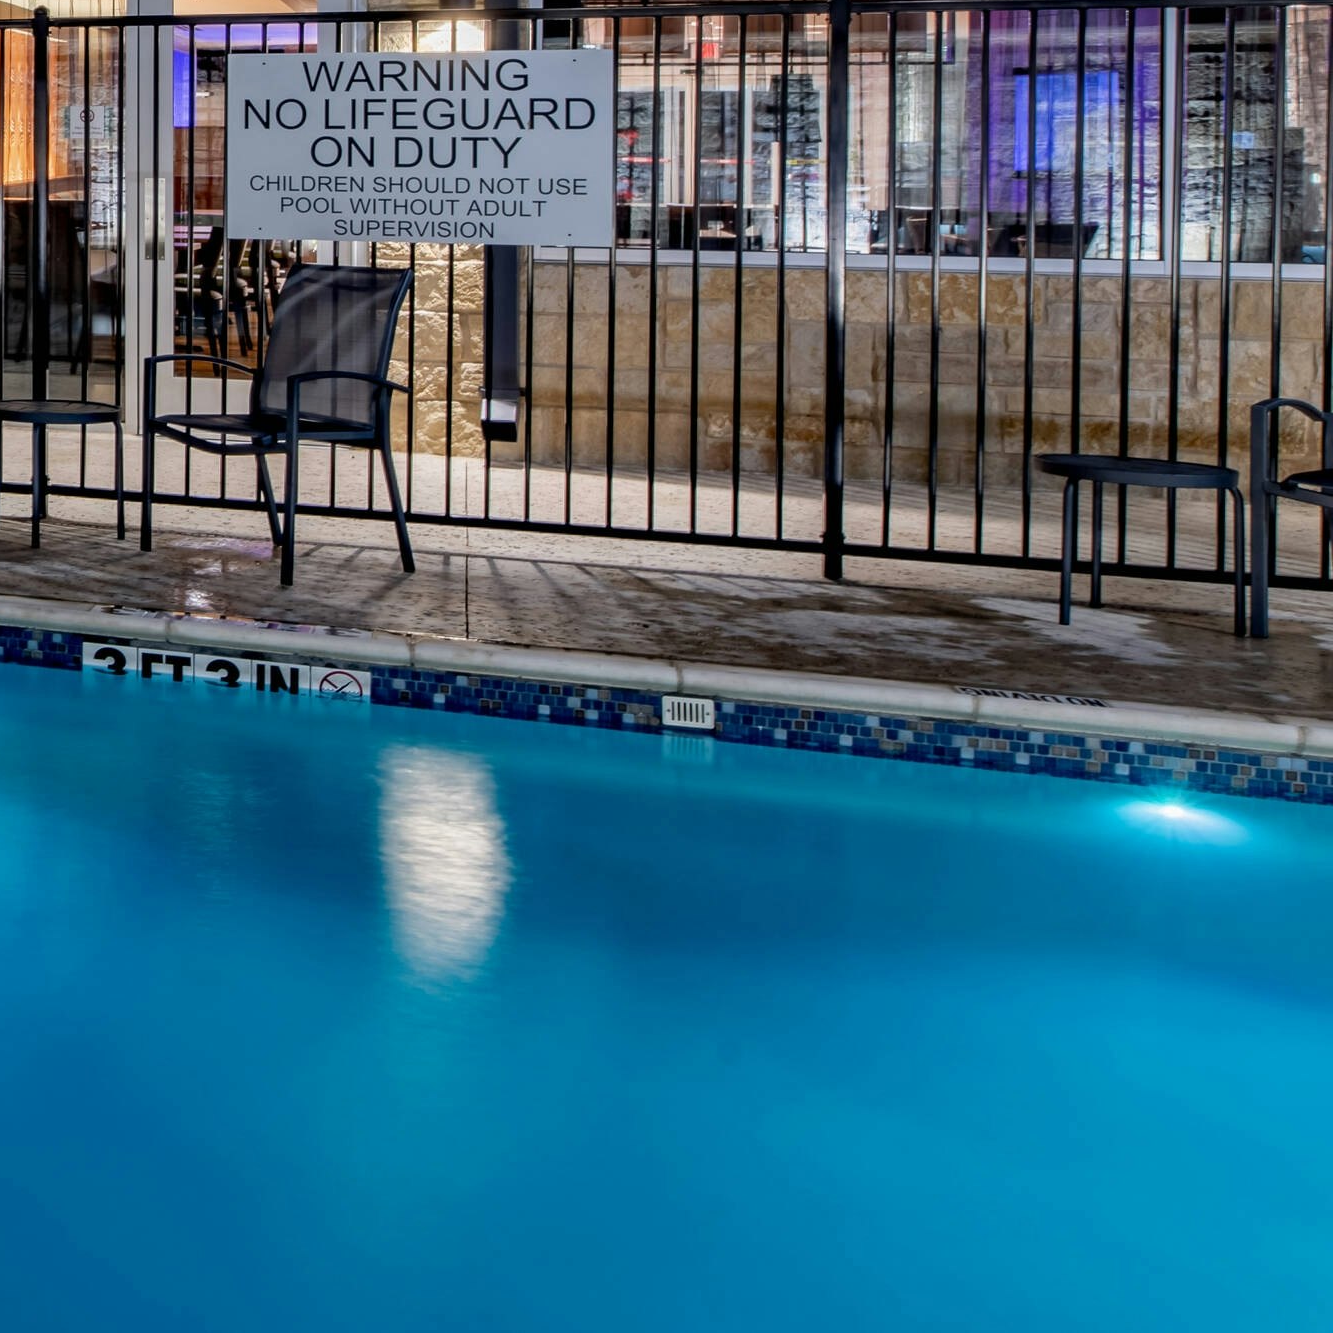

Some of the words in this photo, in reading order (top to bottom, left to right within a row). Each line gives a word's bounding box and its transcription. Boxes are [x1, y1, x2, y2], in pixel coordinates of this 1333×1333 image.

[301, 58, 529, 93] WARNING
[244, 98, 308, 130] NO
[324, 97, 596, 131] LIFEGUARD
[310, 135, 375, 168] ON
[394, 136, 523, 169] DUTY
[249, 174, 365, 193] CHILDREN
[372, 176, 471, 194] SHOULD
[479, 177, 531, 195] NOT
[538, 178, 588, 196] USE
[280, 196, 343, 214] POOL
[349, 197, 460, 216] WITHOUT
[466, 199, 547, 218] ADULT
[333, 218, 494, 239] SUPERVISION
[141, 652, 192, 682] FT
[256, 664, 299, 694] IN
